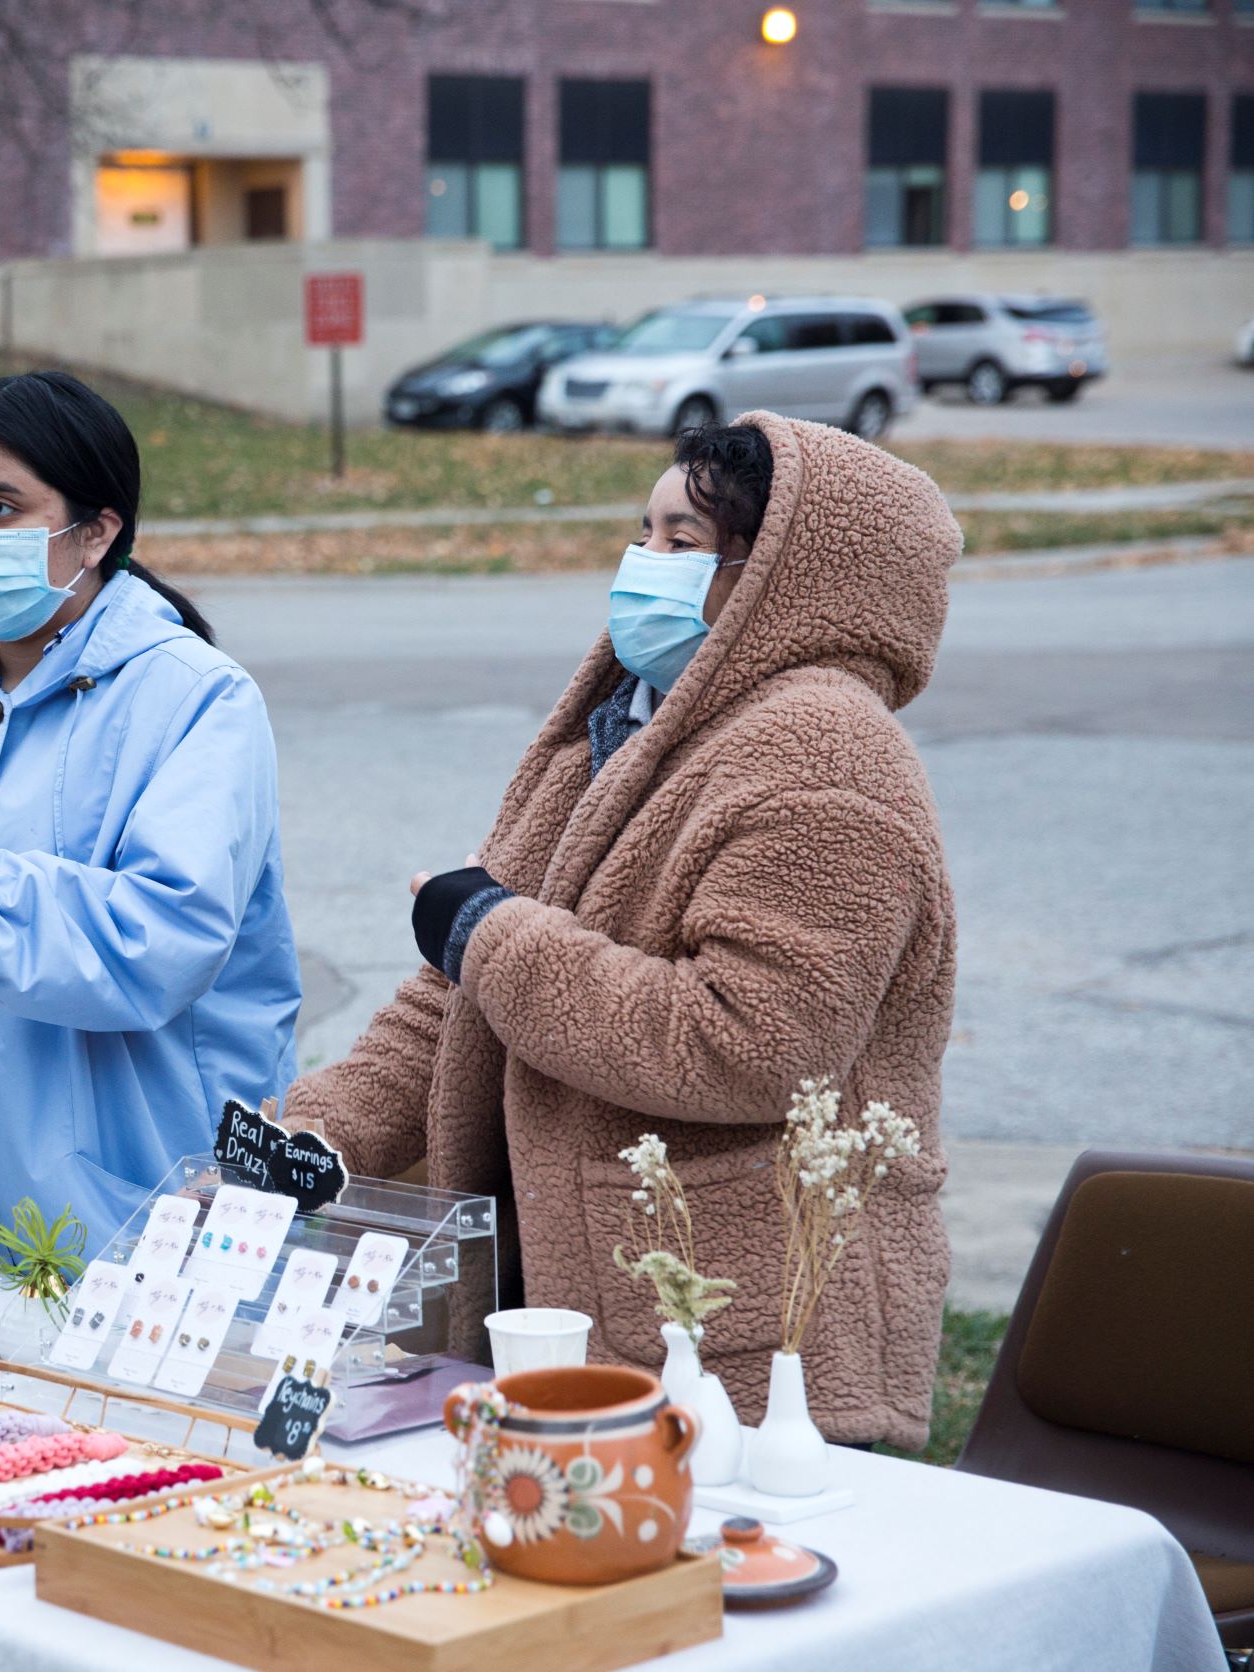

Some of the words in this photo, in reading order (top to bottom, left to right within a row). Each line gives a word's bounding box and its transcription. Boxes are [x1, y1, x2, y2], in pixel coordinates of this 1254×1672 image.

[231, 1111, 264, 1148] Real
[226, 1137, 268, 1187] Druzy
[285, 1143, 333, 1173] Earrings
[292, 1168, 315, 1189] $15
